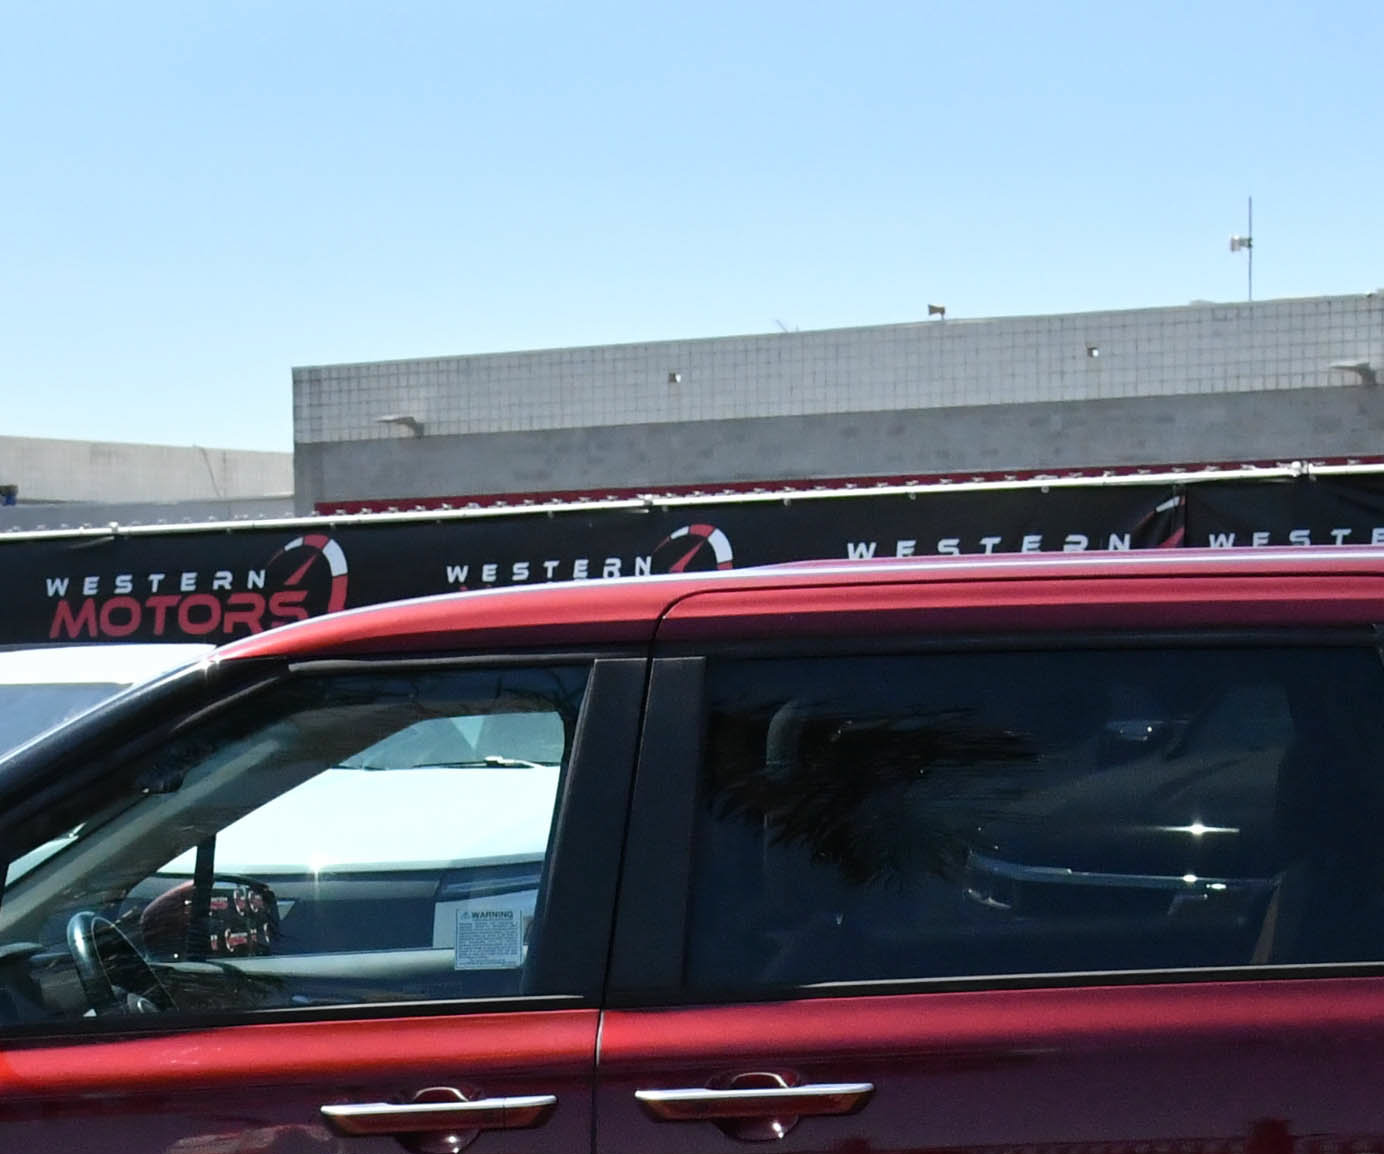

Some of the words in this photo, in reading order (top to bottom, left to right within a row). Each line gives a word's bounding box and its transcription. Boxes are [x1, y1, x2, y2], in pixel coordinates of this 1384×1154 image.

[46, 569, 265, 597] WESTERN
[446, 556, 652, 583] WESTERN
[49, 589, 309, 639] MOTORS
